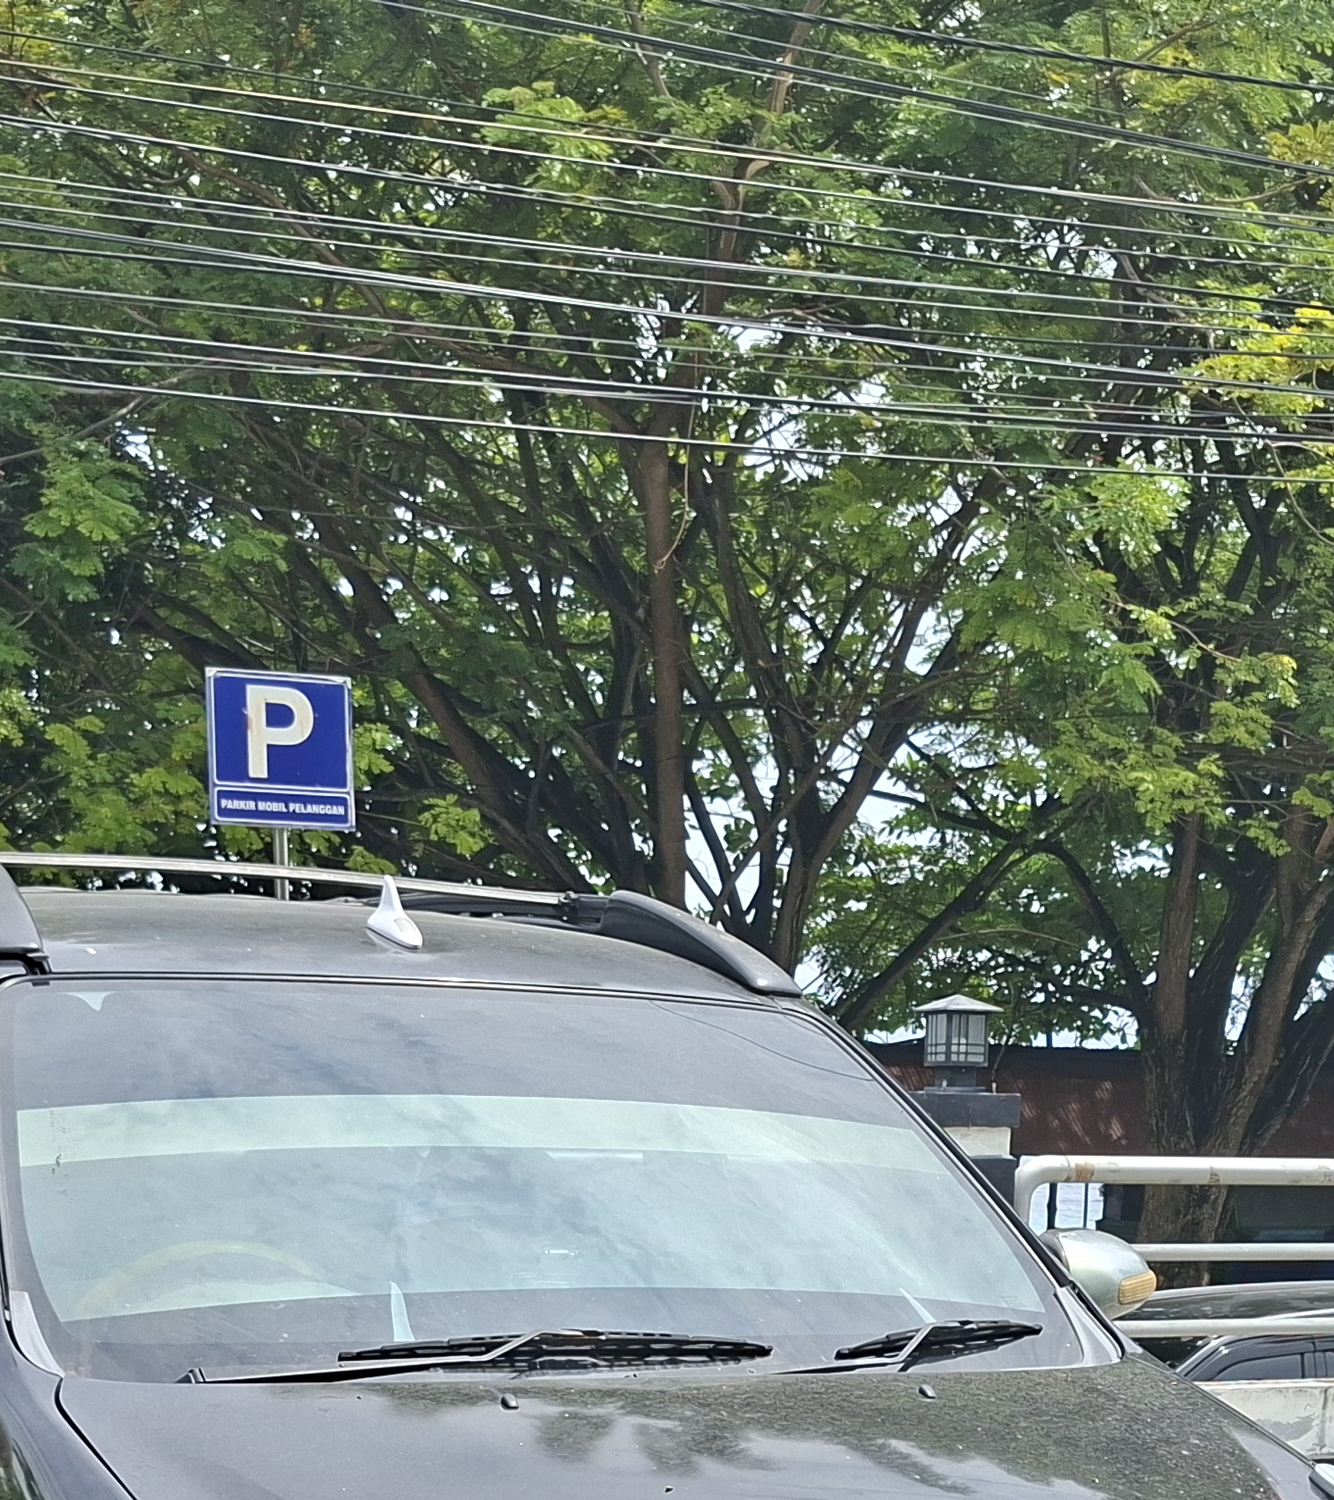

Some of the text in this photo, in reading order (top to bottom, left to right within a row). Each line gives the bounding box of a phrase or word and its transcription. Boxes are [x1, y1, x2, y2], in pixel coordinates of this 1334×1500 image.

[246, 684, 314, 778] P
[221, 798, 345, 816] PARKIR MOBIL PELANGGAN
